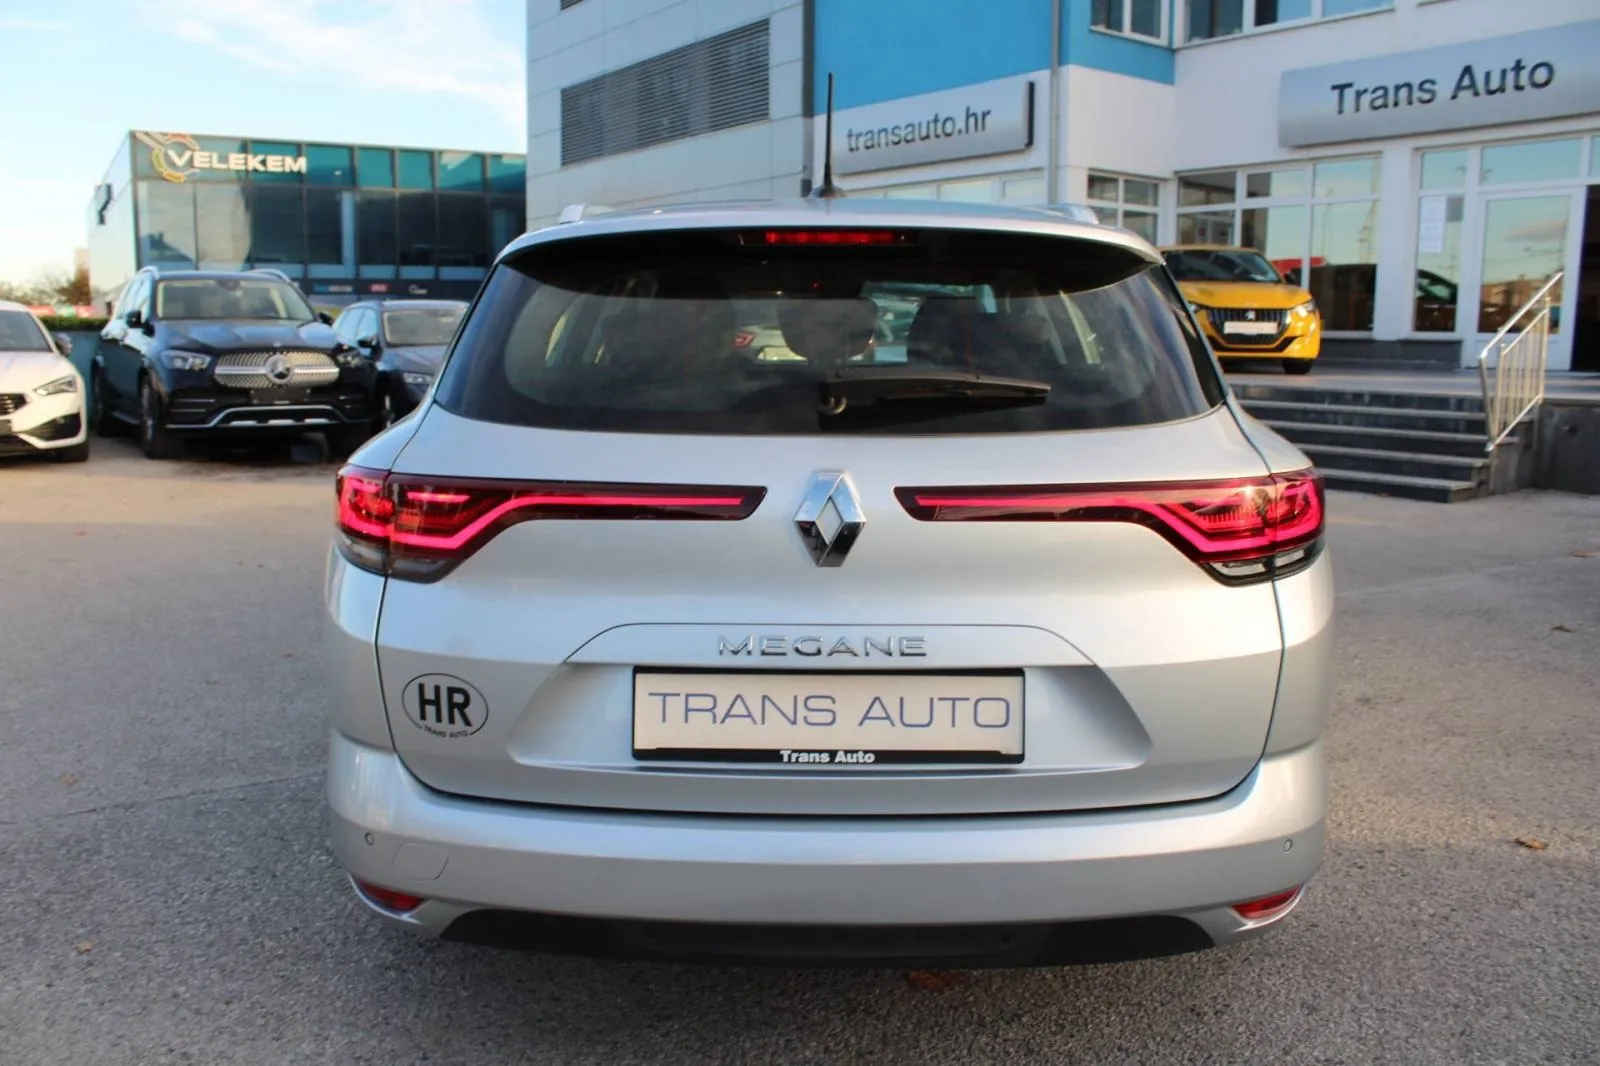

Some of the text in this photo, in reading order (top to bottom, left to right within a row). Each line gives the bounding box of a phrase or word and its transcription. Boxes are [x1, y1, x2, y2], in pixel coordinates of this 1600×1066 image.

[1330, 58, 1555, 115] Trans Auto
[846, 105, 992, 153] transauto.hr
[167, 149, 307, 174] VELEKEM
[718, 635, 928, 657] MEGANE
[418, 682, 473, 728] HR
[648, 692, 1011, 729] TRANS AUTO
[779, 749, 876, 763] Trans Auto
